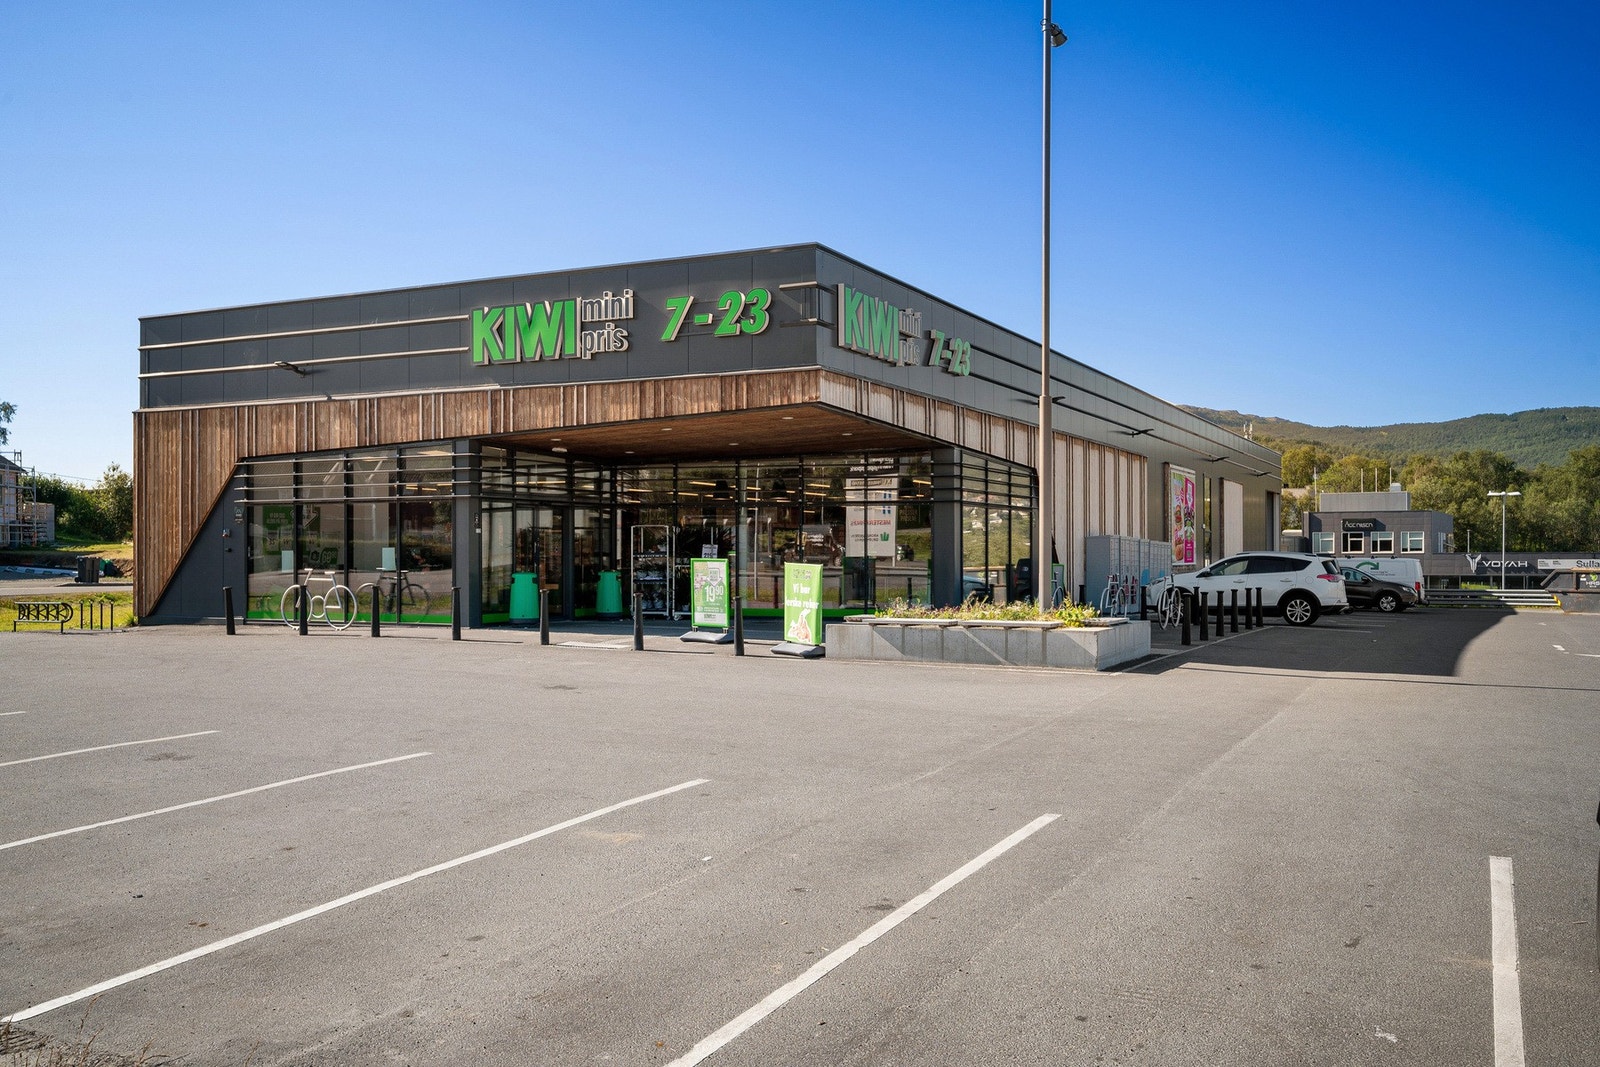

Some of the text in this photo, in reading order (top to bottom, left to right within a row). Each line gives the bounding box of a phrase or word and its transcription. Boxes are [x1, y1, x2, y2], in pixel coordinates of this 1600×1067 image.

[472, 289, 635, 366] KIWI mini
[582, 322, 630, 360] pris
[838, 283, 900, 366] KIWI
[1482, 560, 1528, 568] VOYAH
